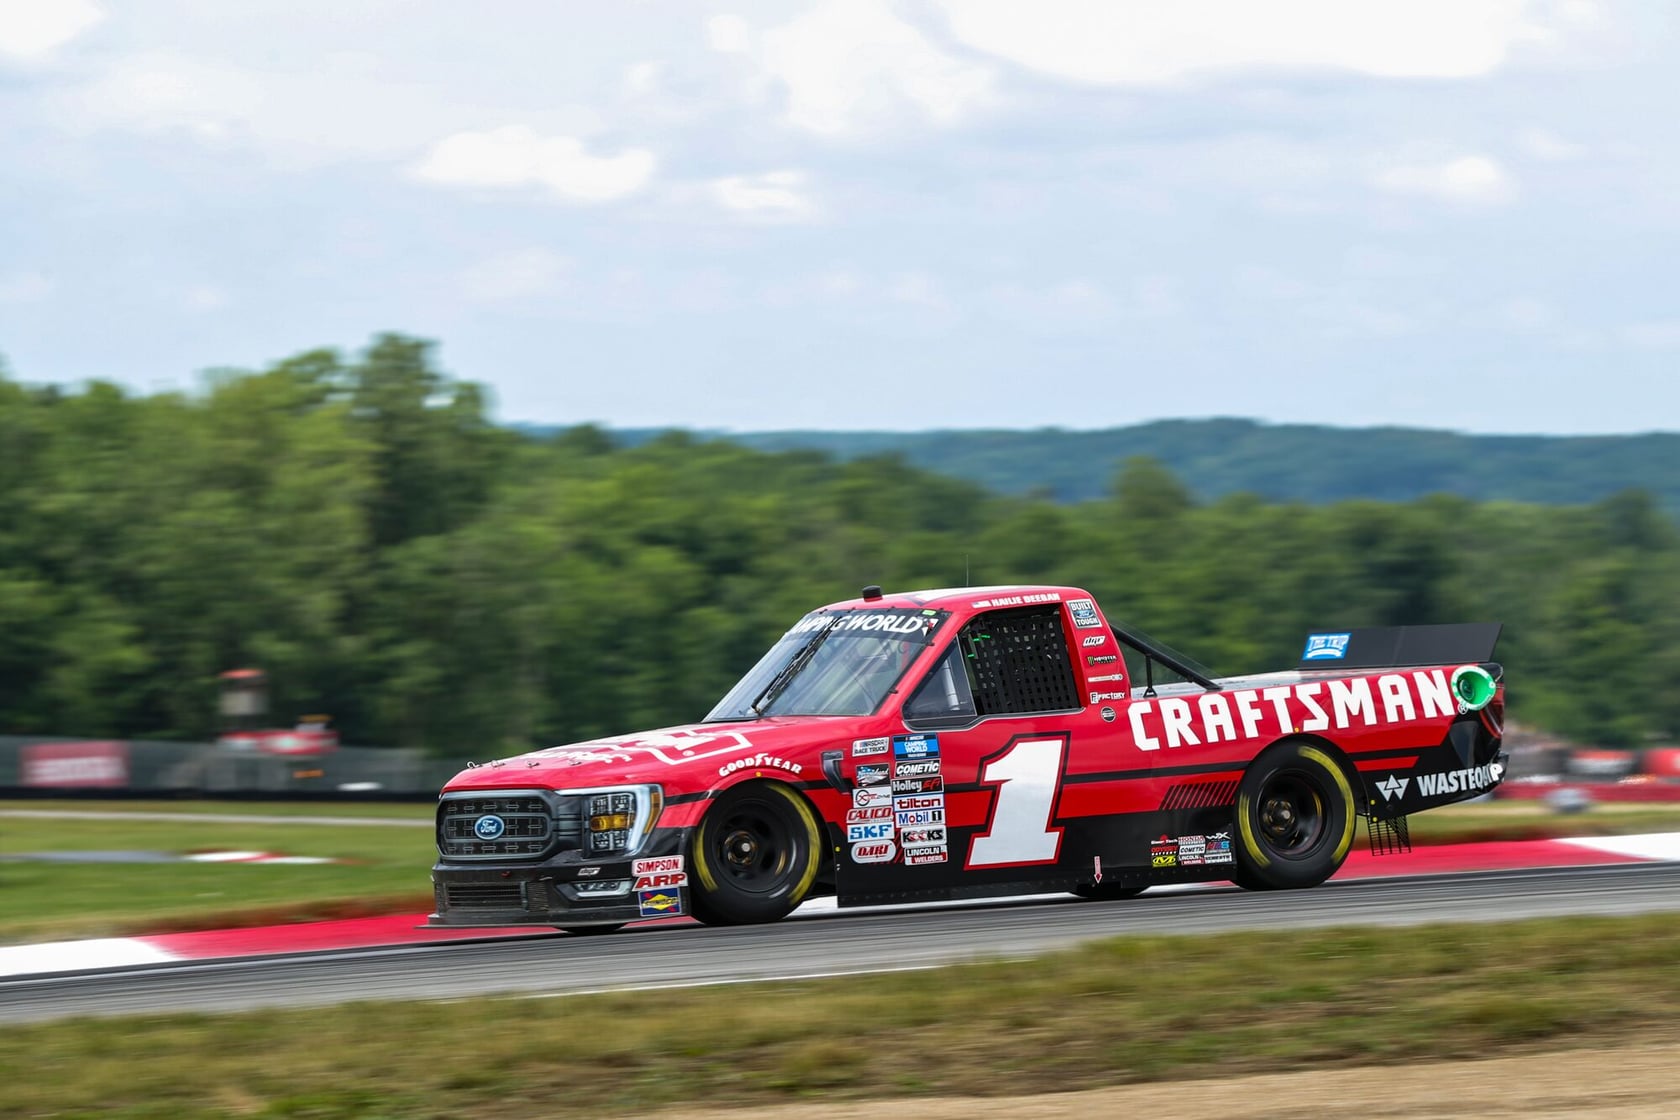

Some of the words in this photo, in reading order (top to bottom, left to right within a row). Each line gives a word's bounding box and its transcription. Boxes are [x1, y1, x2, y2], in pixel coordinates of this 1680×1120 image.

[991, 596, 1023, 606] HAILIE
[1070, 601, 1091, 611] BUILT
[845, 615, 922, 633] WORLD
[1077, 617, 1099, 626] TOUGH
[1127, 669, 1456, 751] CRAFTSMAN
[905, 745, 928, 753] WORLD
[719, 752, 802, 777] GOODYEAR
[896, 761, 939, 775] COMETIC
[892, 780, 922, 792] Holley
[1416, 763, 1503, 797] WASTEQUIP
[897, 798, 940, 809] tilton
[967, 738, 1064, 867] 1
[848, 807, 892, 821] CALICO
[899, 811, 928, 824] Mobil
[932, 811, 942, 821] 1
[849, 824, 892, 840] SKF
[907, 847, 940, 857] LINCOLN
[914, 855, 944, 863] WELDERS
[636, 859, 680, 874] SIMPSON
[635, 873, 686, 889] ARP
